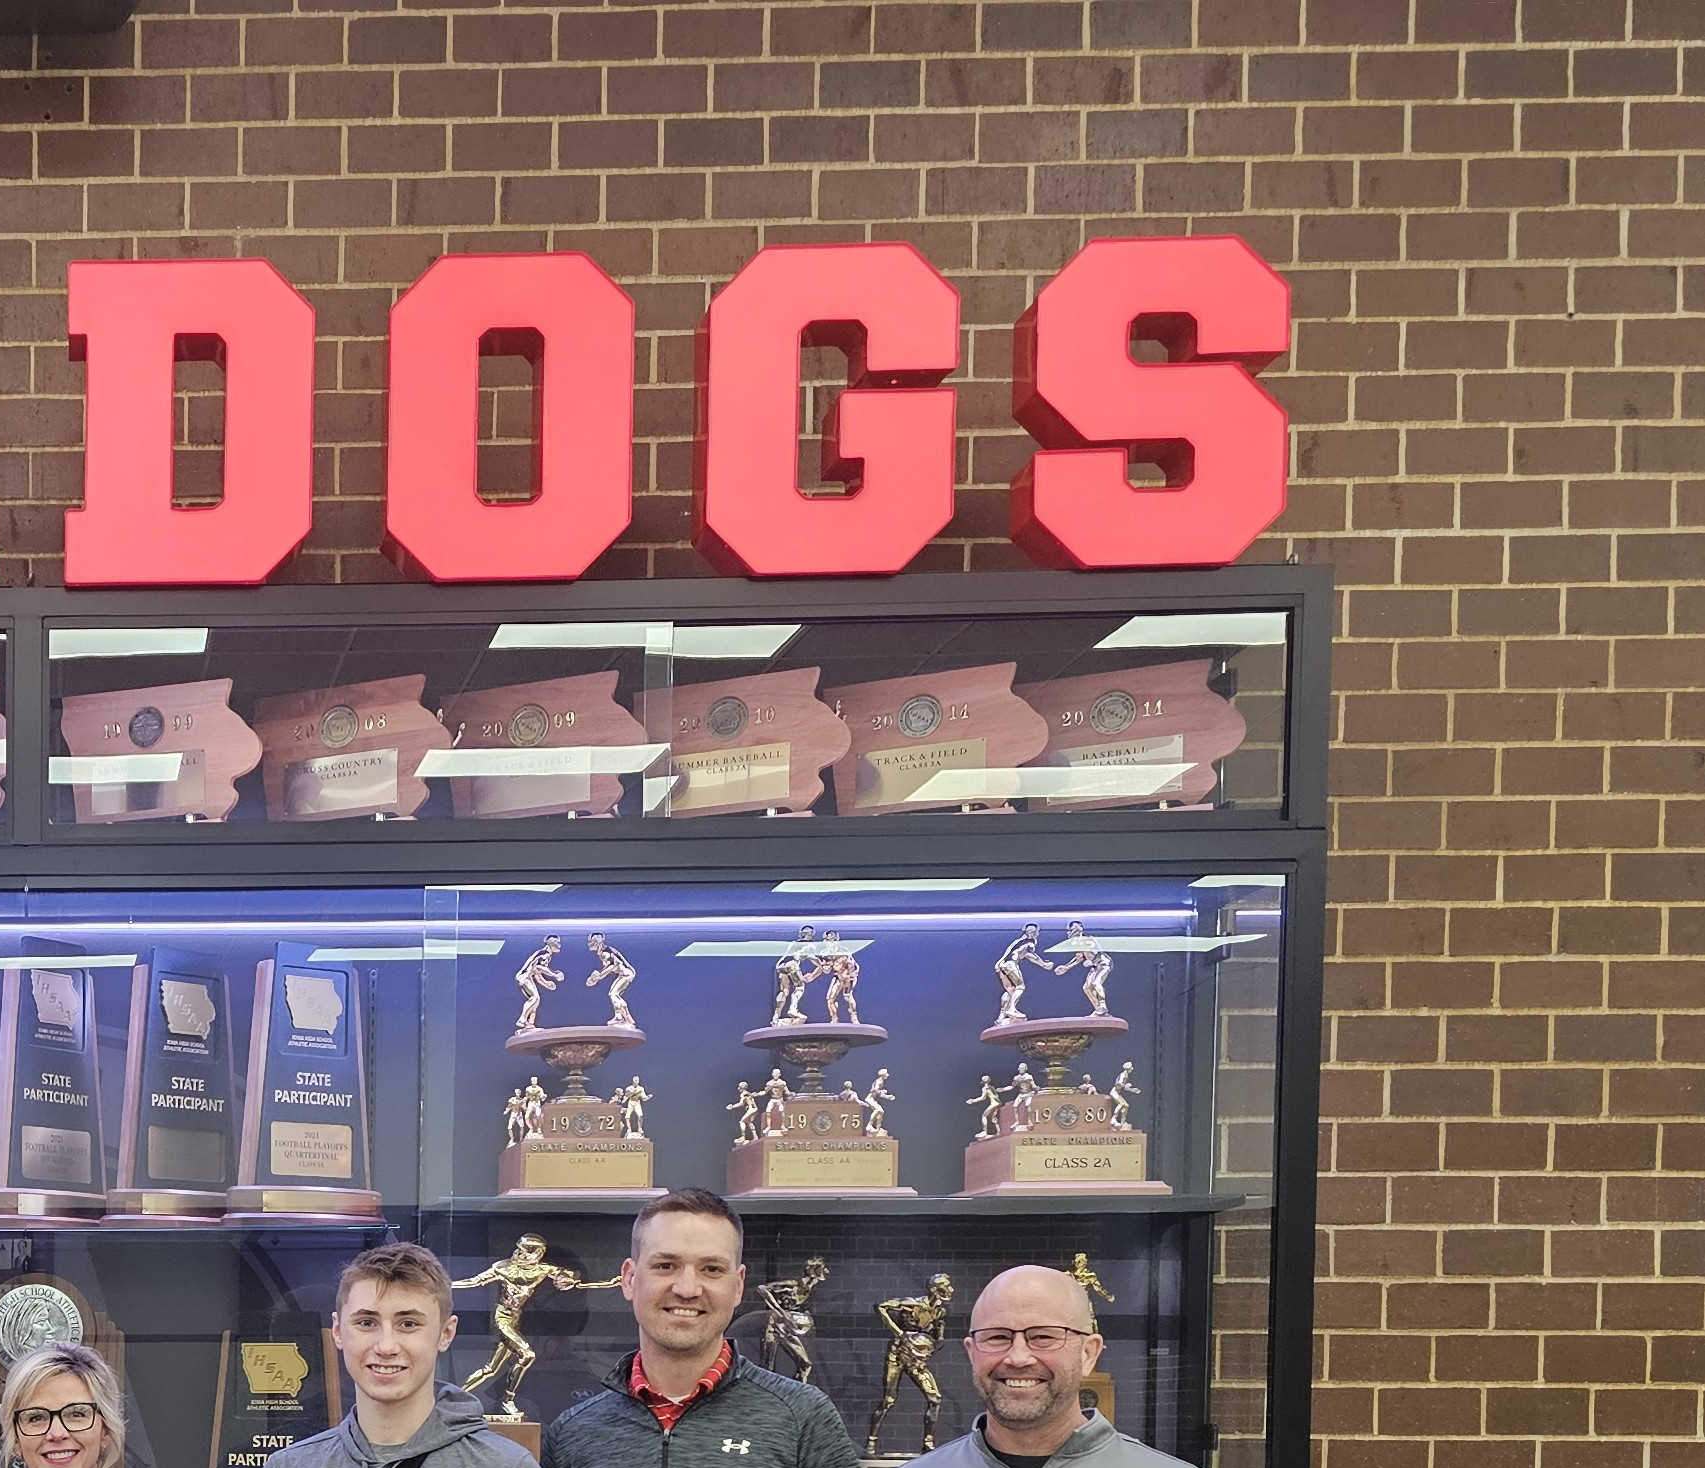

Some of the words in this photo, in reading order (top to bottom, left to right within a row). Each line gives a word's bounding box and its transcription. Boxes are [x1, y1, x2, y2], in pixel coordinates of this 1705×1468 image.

[102, 722, 122, 739] 19
[172, 713, 194, 731] 99
[364, 712, 387, 731] 08
[481, 721, 503, 738] 20
[553, 711, 576, 728] 09
[679, 716, 701, 734] 20
[754, 705, 776, 725] 10
[871, 714, 894, 731] 20
[1061, 710, 1084, 727] 20
[723, 750, 784, 765] BASEBALL
[875, 754, 917, 766] TRACK
[918, 752, 928, 760] &
[930, 747, 968, 759] FIELD
[1081, 746, 1149, 761] BASEBALL
[331, 757, 384, 771] COUNTRY
[706, 765, 735, 775] CLASS
[899, 762, 929, 771] CLASS
[930, 760, 942, 768] 3A
[321, 771, 347, 781] CLASS
[36, 974, 72, 1022] IHSAA
[41, 1072, 72, 1088] STATE
[171, 1076, 205, 1092] STATE
[296, 1071, 332, 1087] STATE
[23, 1087, 89, 1107] PARTICIPANT
[151, 1093, 225, 1113] PARTICIPANT
[274, 1089, 353, 1108] PARTICIPANT
[551, 1116, 570, 1131] 19
[597, 1115, 615, 1130] 72
[787, 1113, 807, 1129] 19
[840, 1113, 861, 1129] 75
[1034, 1107, 1053, 1123] 19
[1084, 1107, 1107, 1122] 80
[274, 1139, 312, 1149] FOOTBALL
[313, 1141, 349, 1151] PLAYOFFS
[531, 1143, 567, 1151] STATE
[577, 1142, 644, 1151] CHAMPIONS
[776, 1141, 812, 1150] STATE
[822, 1141, 888, 1150] CHAMPIONS
[1021, 1137, 1057, 1145] STATE
[1068, 1136, 1134, 1145] CHAMPIONS
[284, 1150, 339, 1161] QUARTERFINAL
[569, 1157, 591, 1165] CLASS
[807, 1157, 834, 1165] CLASS
[1044, 1157, 1089, 1169] CLASS
[1093, 1157, 1112, 1168] 2A
[19, 1287, 56, 1300] SCHOOL
[57, 1296, 81, 1339] ATHLETIC
[247, 1346, 295, 1390] IHSAA
[252, 1434, 294, 1448] STATE
